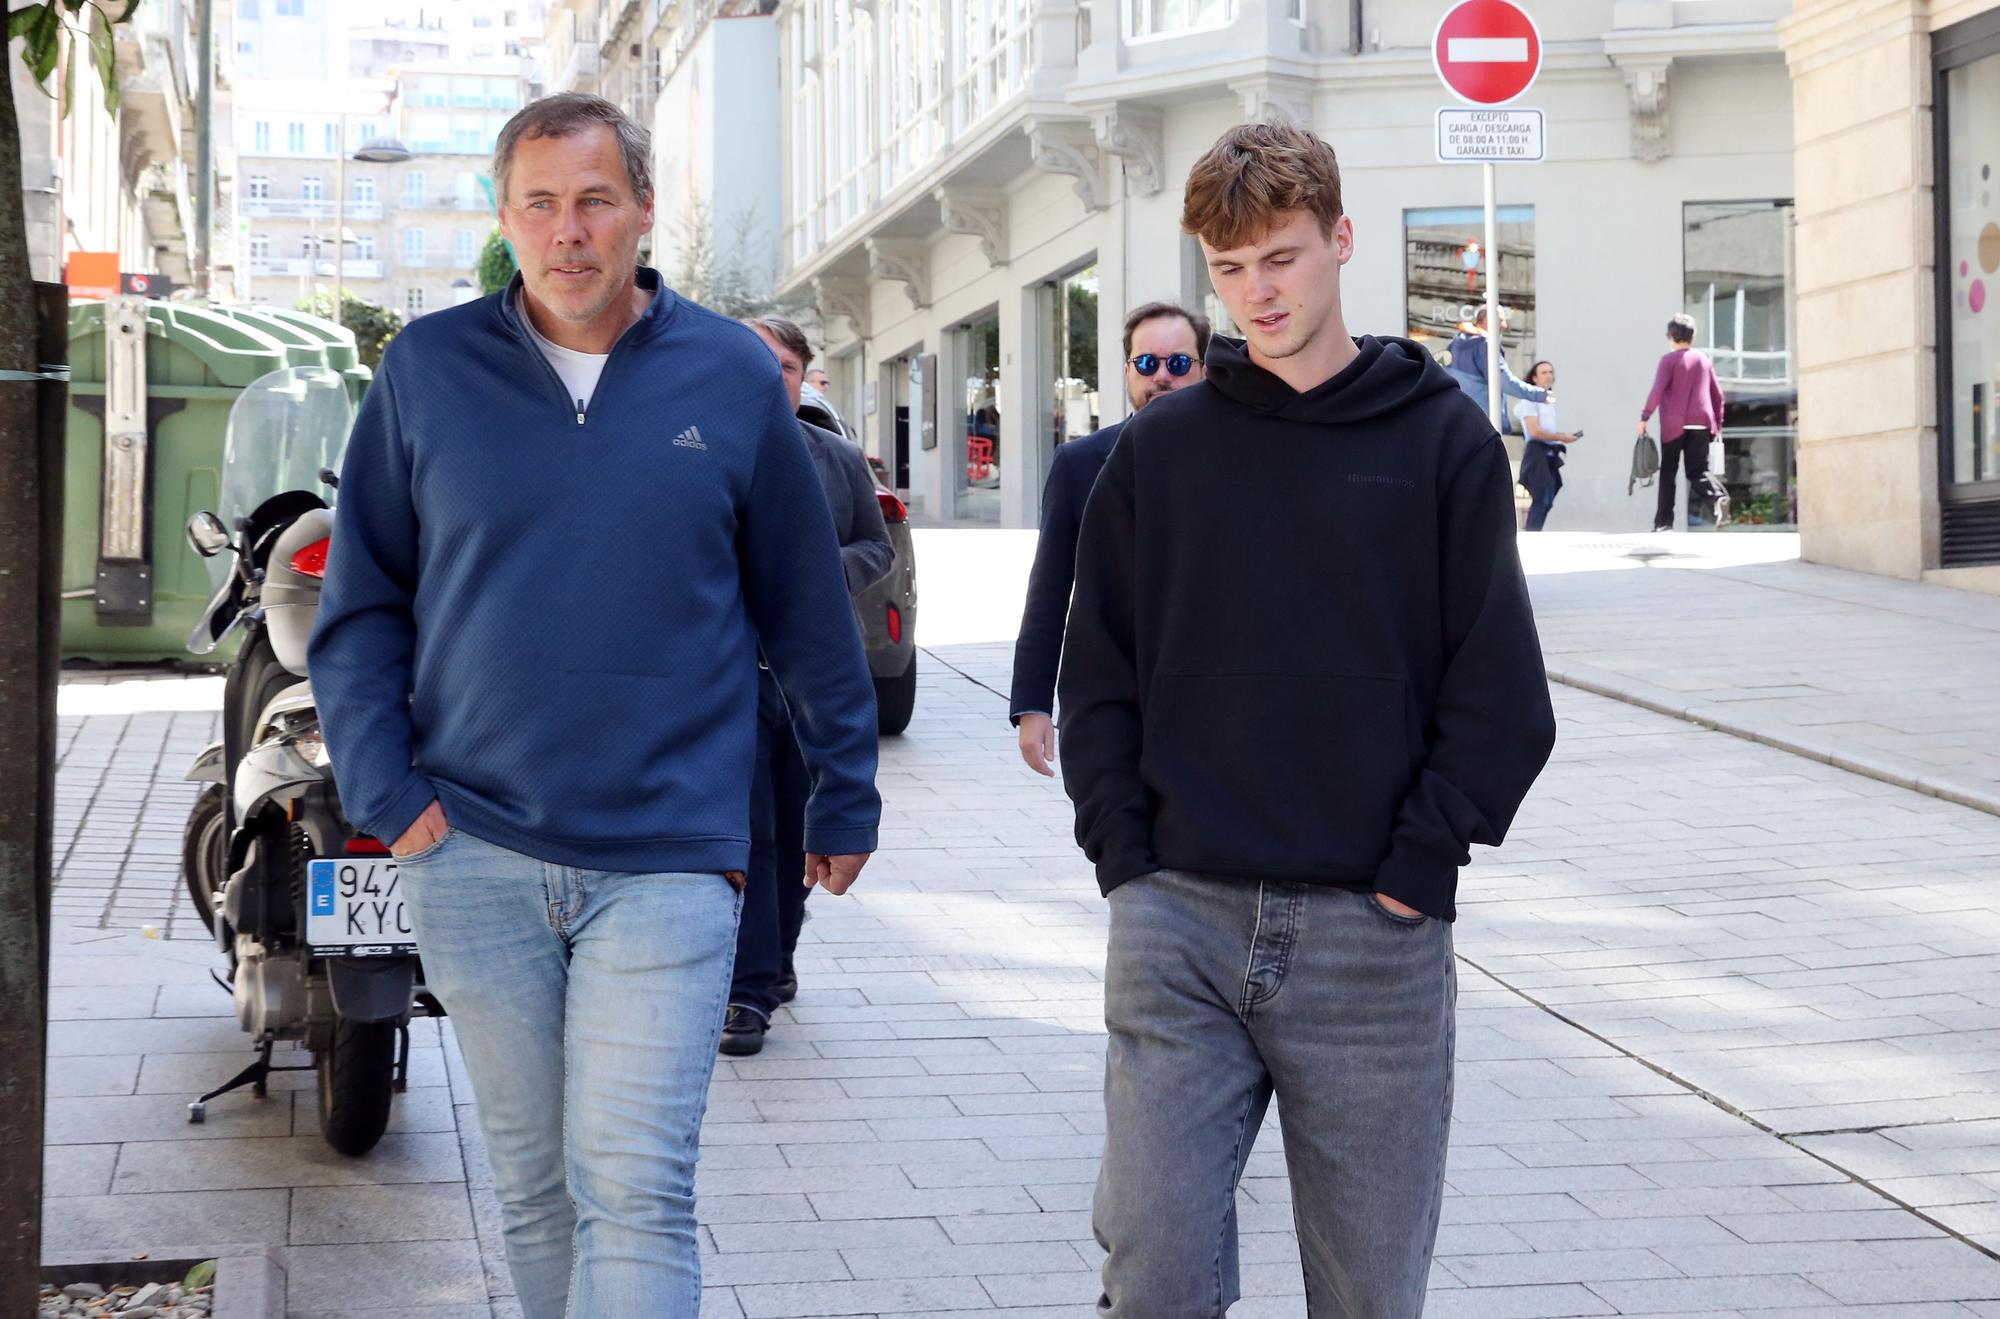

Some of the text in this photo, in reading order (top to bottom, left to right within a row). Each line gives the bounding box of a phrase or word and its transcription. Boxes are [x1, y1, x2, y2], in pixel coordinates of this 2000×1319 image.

[1471, 112, 1509, 122] EXCEPTO
[1449, 124, 1478, 133] CARGA
[1485, 124, 1531, 134] DESCARGA
[1449, 135, 1461, 144] DE
[1488, 135, 1494, 144] A
[1457, 146, 1497, 155] GARAXES
[1507, 146, 1525, 155] TAXI
[673, 439, 707, 450] adidas
[340, 865, 399, 898] 947
[317, 895, 329, 907] E
